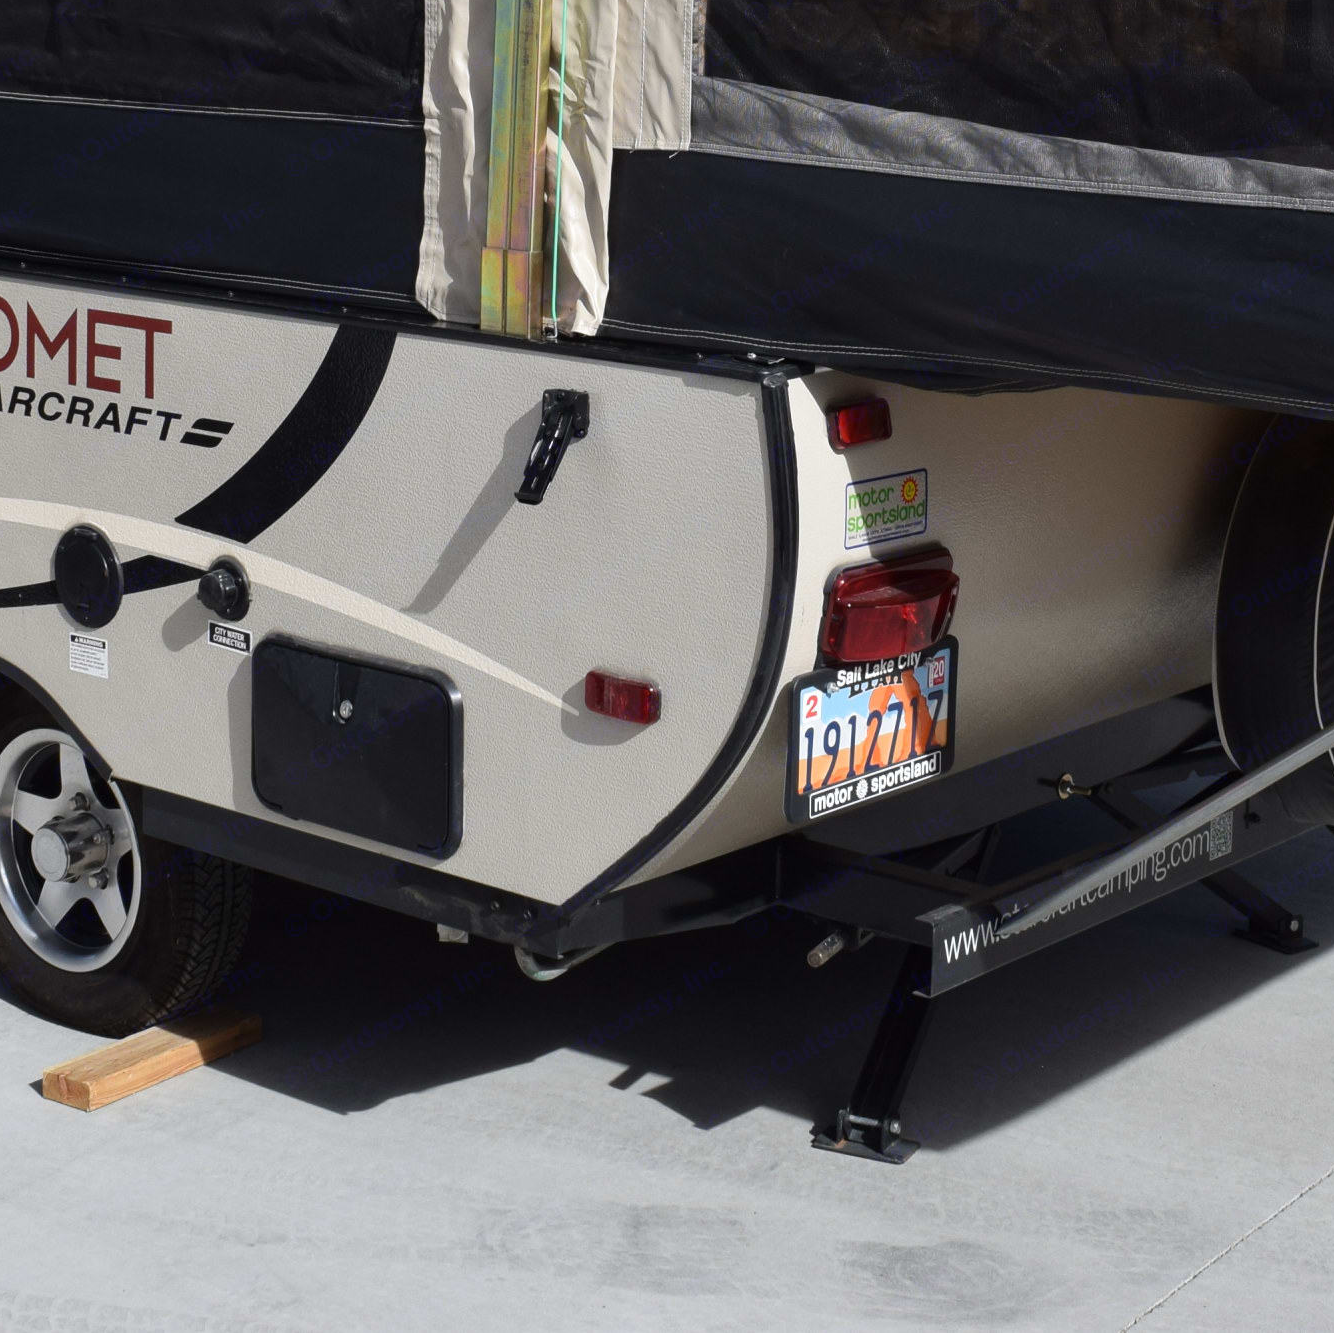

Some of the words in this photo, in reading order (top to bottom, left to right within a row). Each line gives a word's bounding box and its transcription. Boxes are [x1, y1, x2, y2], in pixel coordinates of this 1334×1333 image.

[848, 486, 895, 509] motor
[848, 499, 925, 532] sportsland
[213, 634, 247, 650] CONNECTION
[214, 626, 227, 637] CITY
[837, 666, 864, 687] Salt
[865, 659, 895, 679] Lake
[898, 651, 923, 671] City
[933, 660, 945, 678] 20
[805, 694, 819, 719] 2
[814, 787, 853, 813] motor
[870, 758, 937, 795] sportsland
